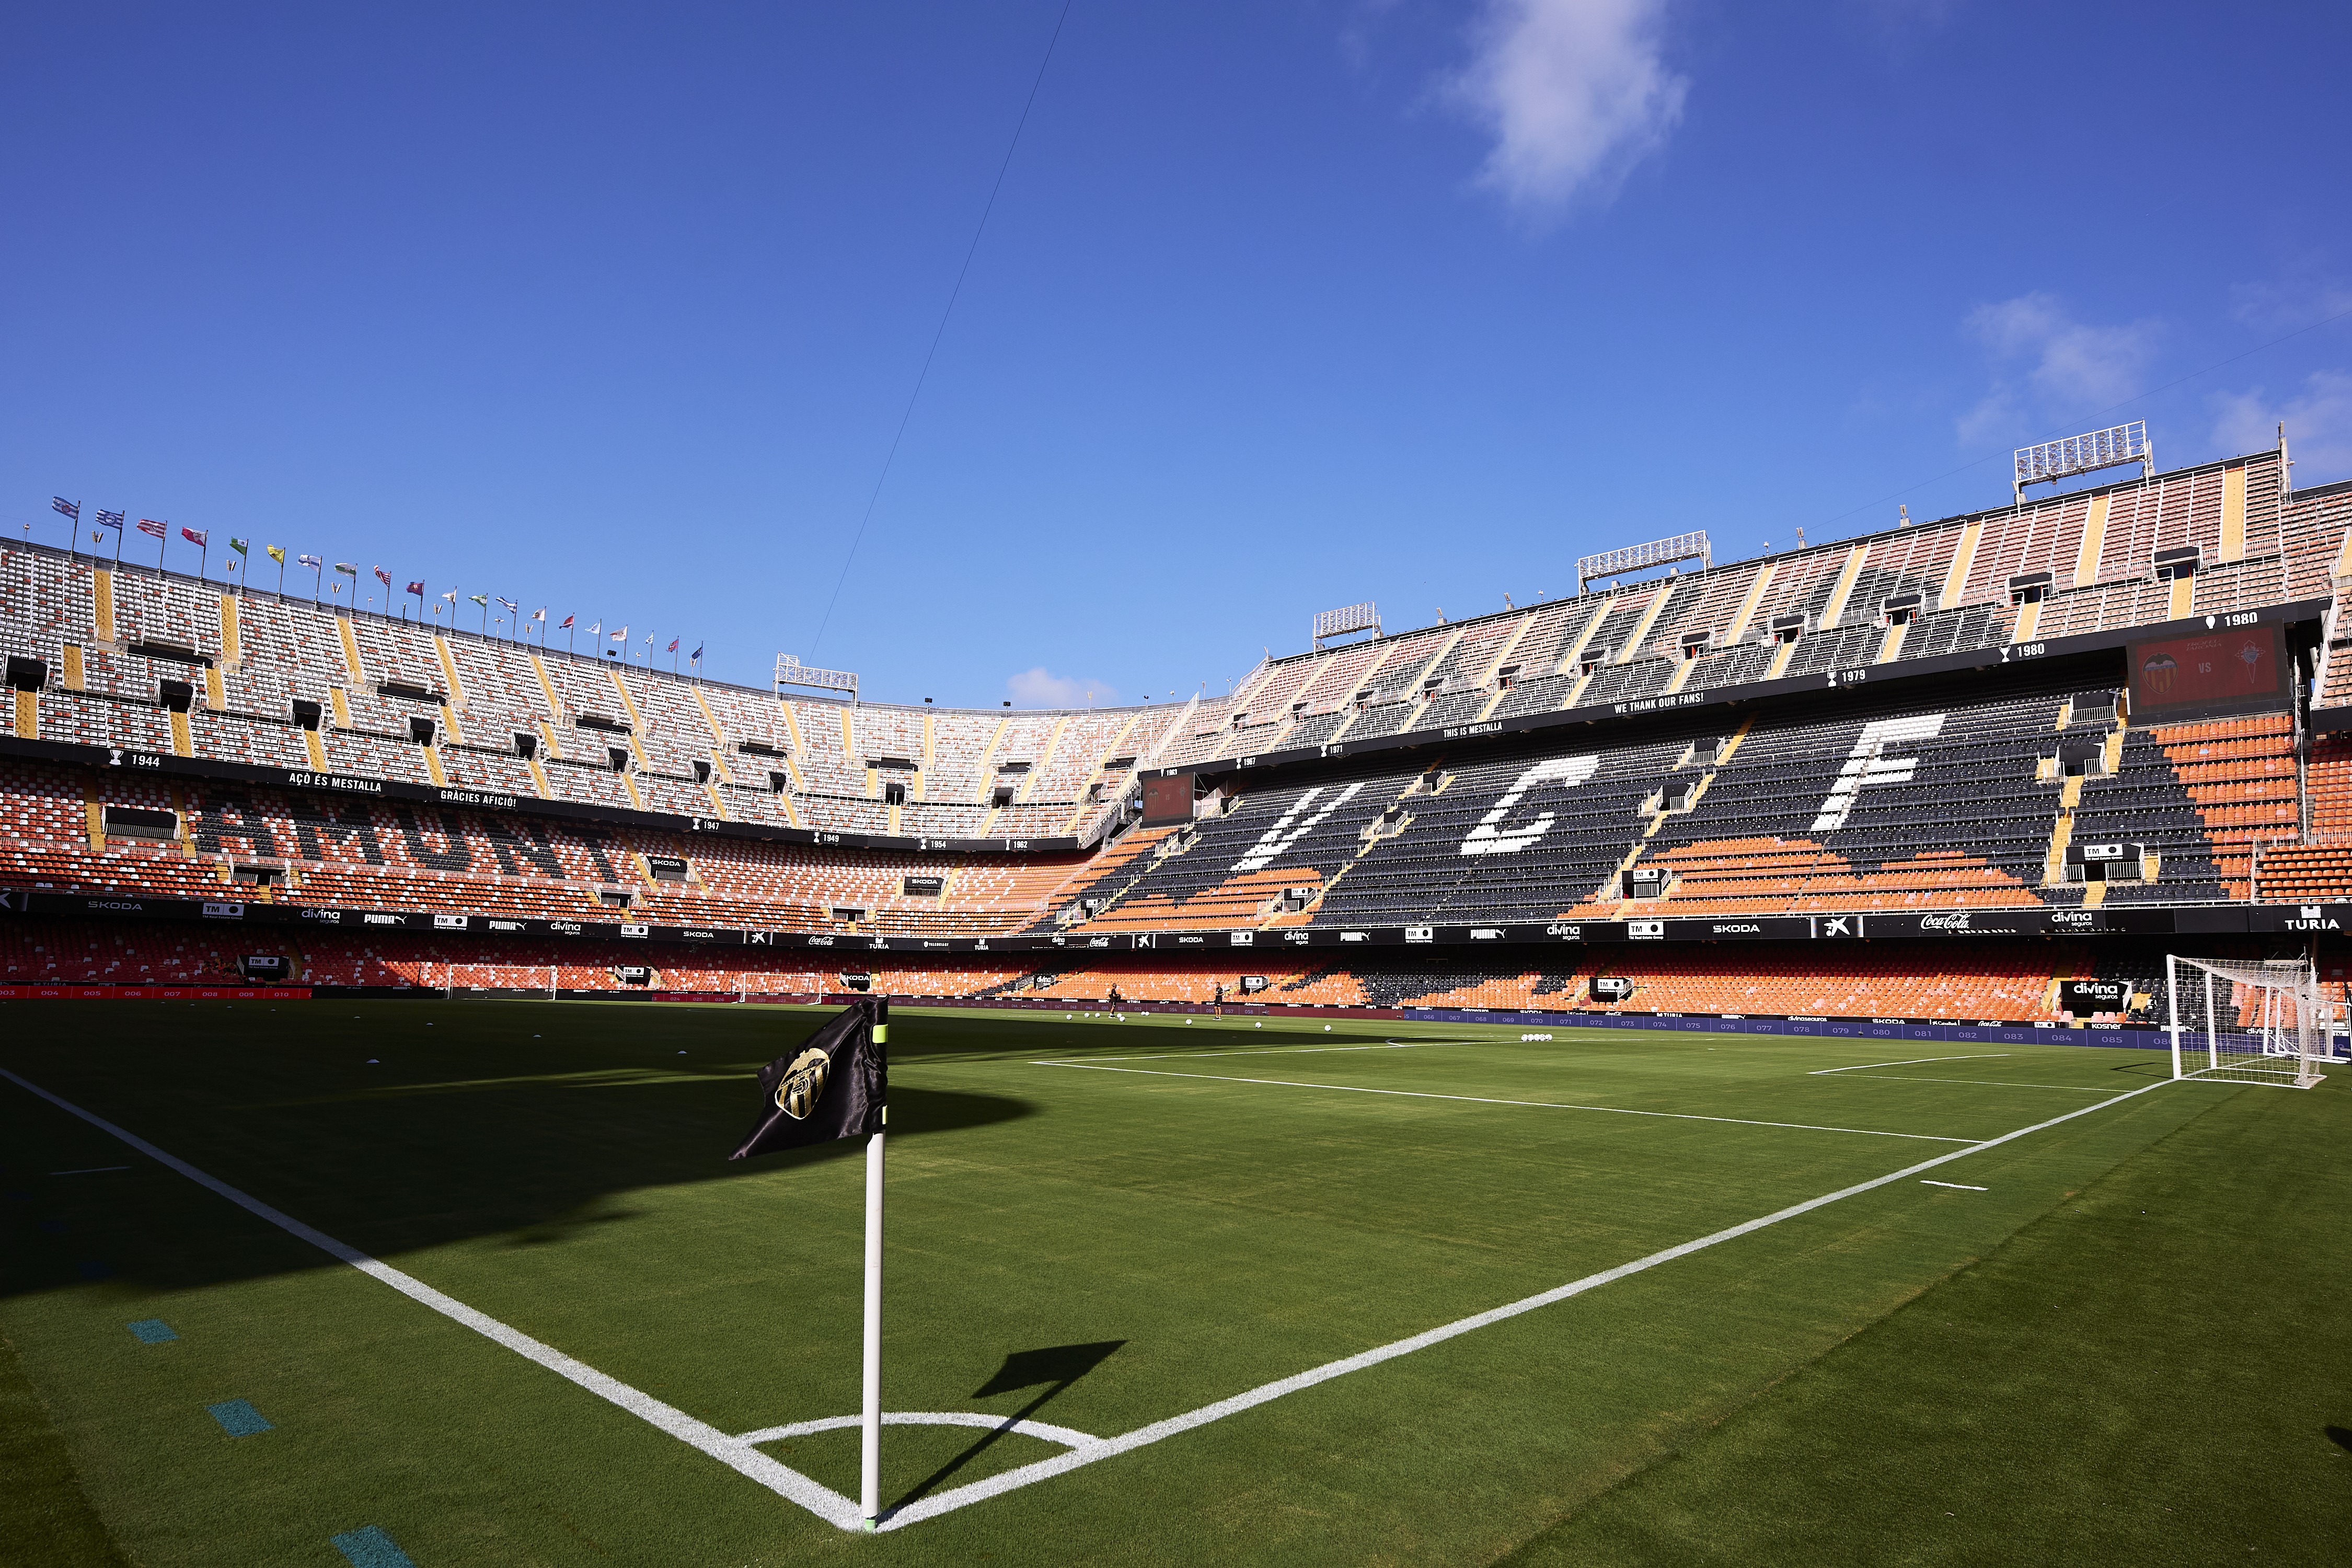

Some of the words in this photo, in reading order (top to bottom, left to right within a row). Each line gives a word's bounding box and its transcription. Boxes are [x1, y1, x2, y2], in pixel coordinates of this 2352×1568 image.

[2224, 612, 2258, 627] 1980
[2016, 643, 2045, 658] 1980
[2198, 662, 2211, 674] VS
[1842, 669, 1866, 682] 1979
[1615, 704, 1628, 714] WE
[1629, 699, 1656, 712] THANK
[1658, 696, 1677, 708] OUR
[1679, 693, 1704, 705] FANS!
[1444, 728, 1458, 738] THIS
[1460, 726, 1467, 736] IS
[1469, 721, 1503, 734] MESTALLA
[1330, 745, 1343, 754] 1971
[132, 755, 160, 767] 1944
[1243, 757, 1255, 766] 1967
[289, 772, 311, 786] AÇÒ
[315, 774, 328, 786] ÉS
[331, 777, 382, 792] MESTALLA
[1460, 754, 1599, 855] C
[1811, 714, 1946, 831] F
[441, 790, 480, 803] GRÀCIES
[482, 794, 516, 807] AFICIÓ!
[704, 821, 719, 830] 1947
[823, 834, 839, 842] 1949
[302, 908, 341, 919] divina
[2051, 912, 2092, 923] divina
[364, 914, 396, 925] PUMA
[1920, 914, 1972, 929] Coca-Cola
[2284, 918, 2340, 930] TURIA
[489, 920, 516, 931] PUMA
[550, 921, 581, 931] divina
[1547, 924, 1580, 935] divina
[1284, 931, 1309, 940] divina
[1340, 932, 1363, 941] PUMA
[1470, 929, 1497, 939] PUMA
[808, 936, 835, 946] Coca-Cola
[2073, 982, 2118, 995] divina
